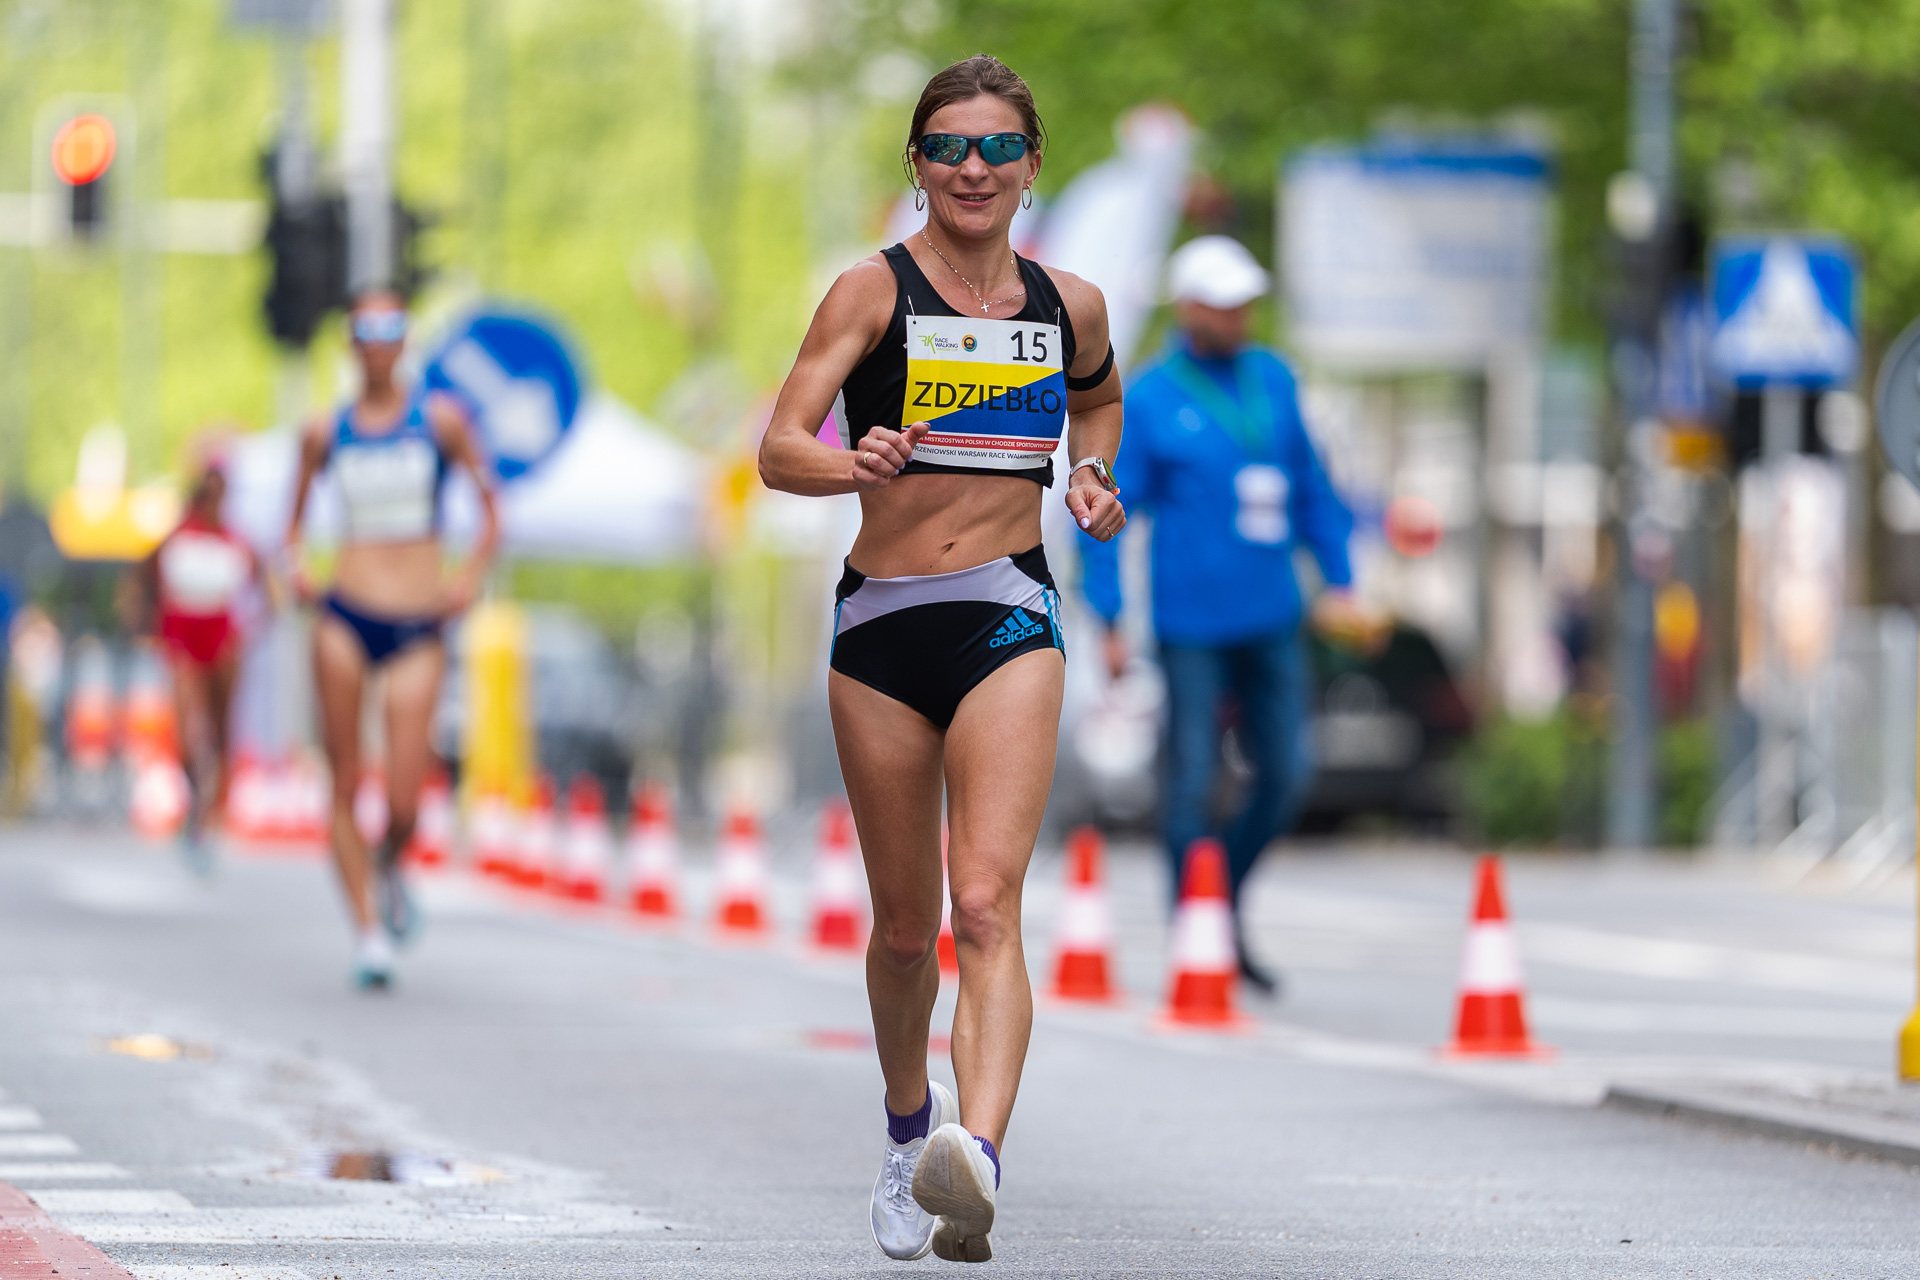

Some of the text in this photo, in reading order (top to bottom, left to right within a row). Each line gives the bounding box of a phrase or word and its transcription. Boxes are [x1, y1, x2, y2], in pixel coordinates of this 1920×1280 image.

[1010, 330, 1047, 363] 15
[911, 381, 1061, 415] ZDZIEBŁO
[913, 445, 957, 456] RZENIOWSKI
[957, 450, 988, 459] WARSAW
[988, 451, 1006, 459] RACE
[924, 436, 965, 445] MISTRZOSTWA
[991, 440, 1016, 448] CHODZIE
[1016, 441, 1044, 449] SPORTOWYM
[989, 623, 1044, 648] adidas
